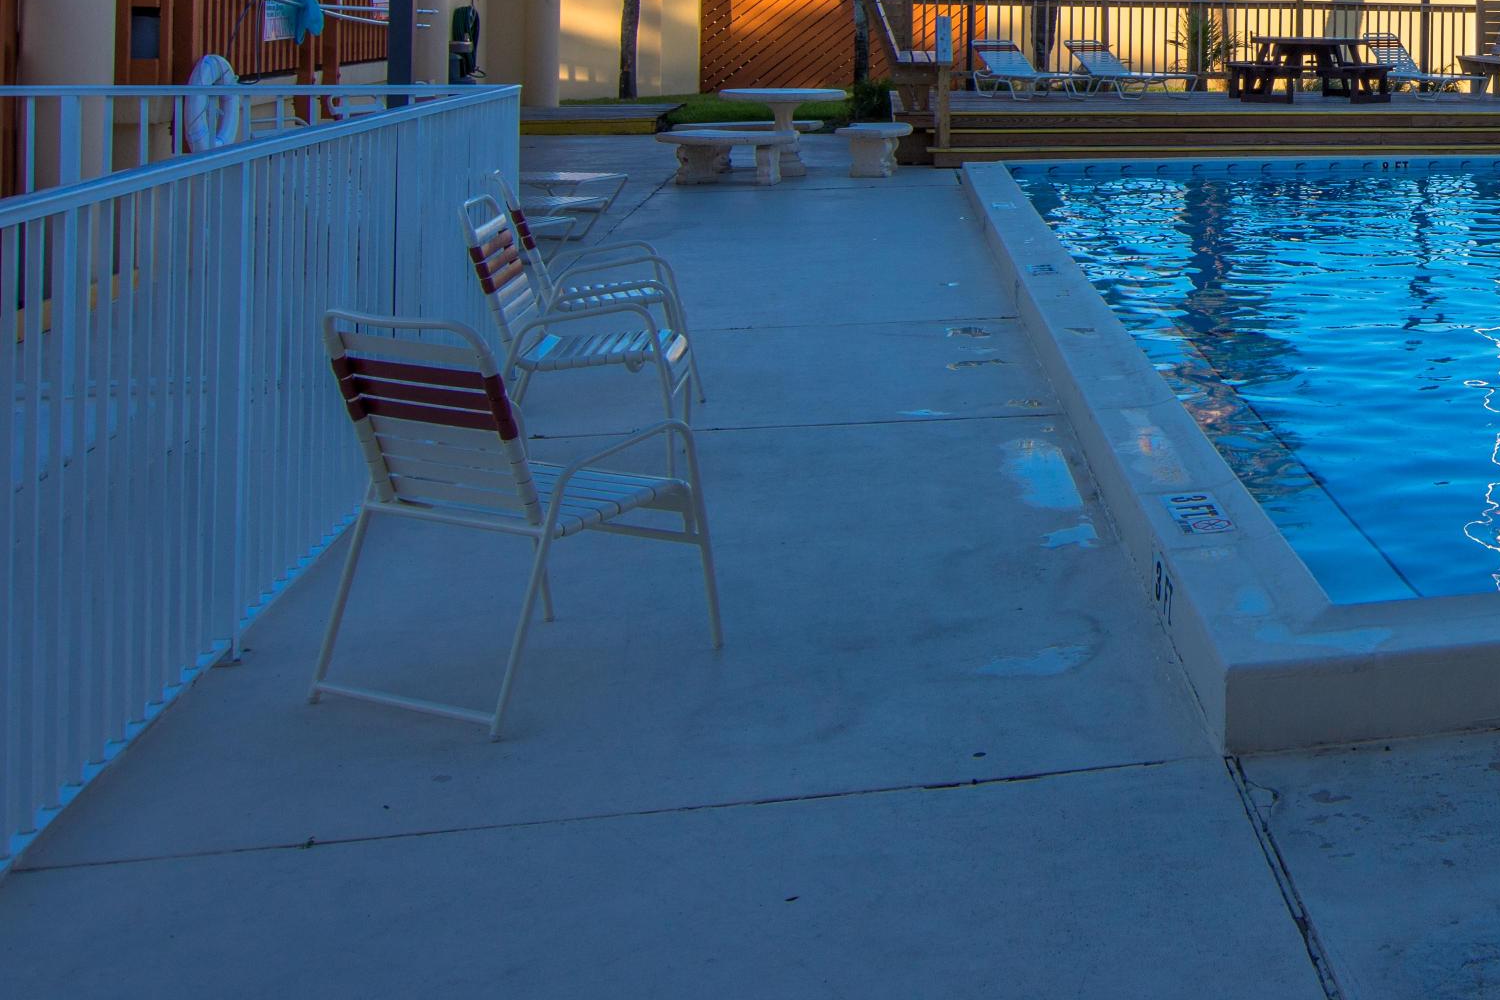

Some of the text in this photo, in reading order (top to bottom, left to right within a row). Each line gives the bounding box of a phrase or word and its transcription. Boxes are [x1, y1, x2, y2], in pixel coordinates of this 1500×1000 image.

[1170, 495, 1208, 503] 3
[1175, 504, 1219, 518] FT
[1155, 561, 1173, 626] 3 FT
